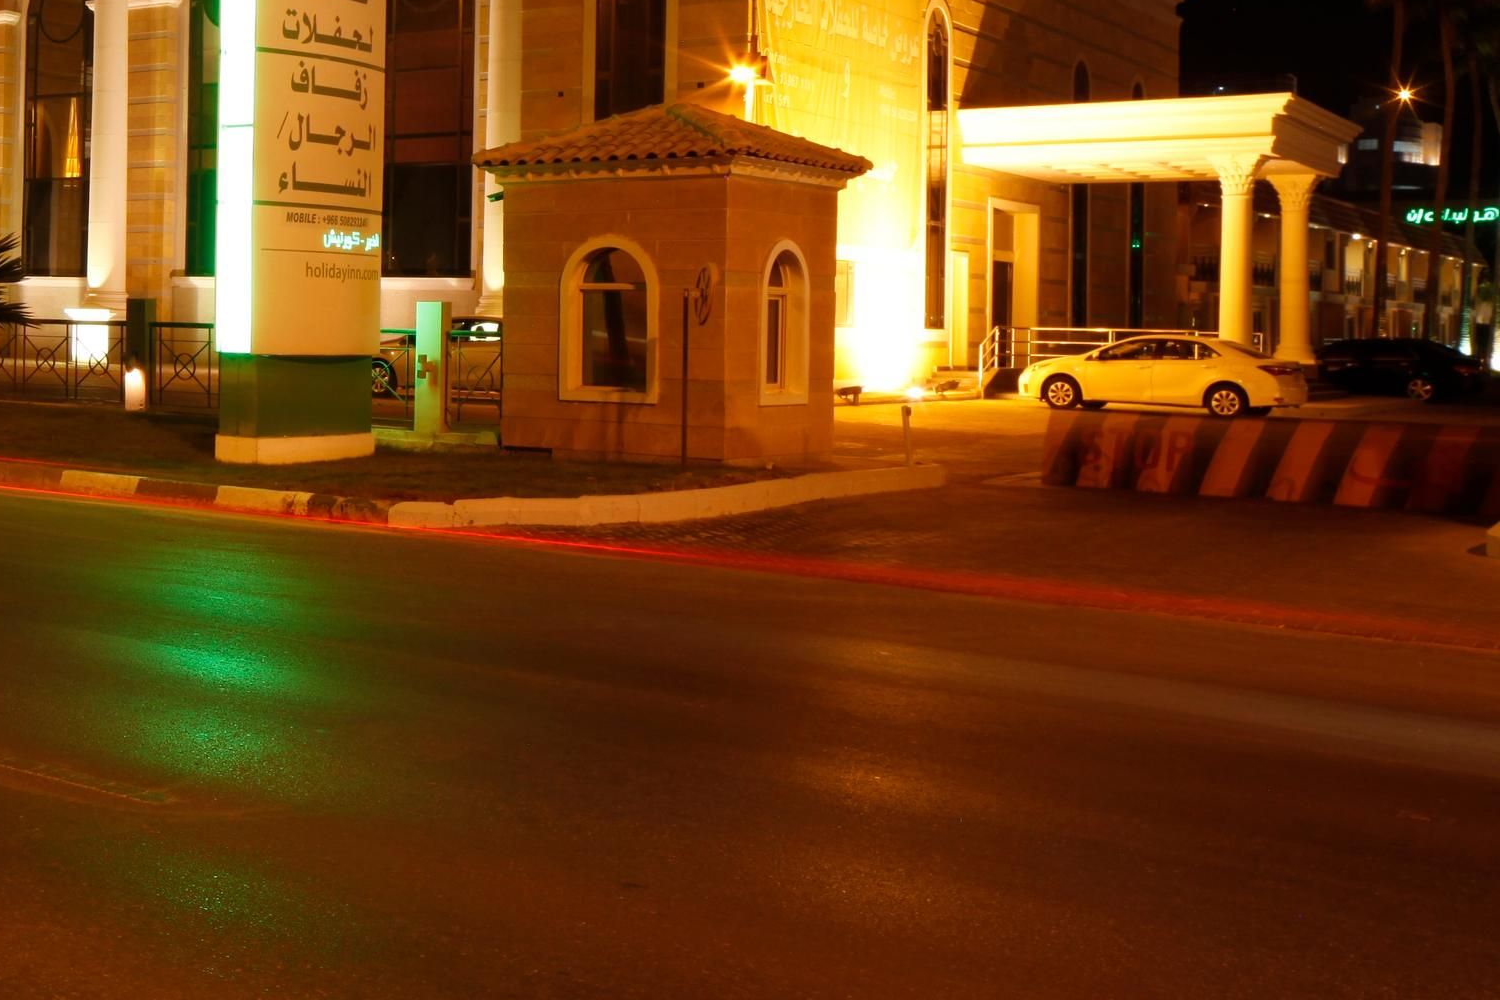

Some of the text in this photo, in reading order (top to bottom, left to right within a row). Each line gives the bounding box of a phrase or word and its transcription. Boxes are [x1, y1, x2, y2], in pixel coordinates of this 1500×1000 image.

[290, 60, 369, 111] زفاف
[277, 160, 372, 199] النساء
[286, 211, 316, 225] MOBILE
[304, 261, 380, 282] holidayinn.com
